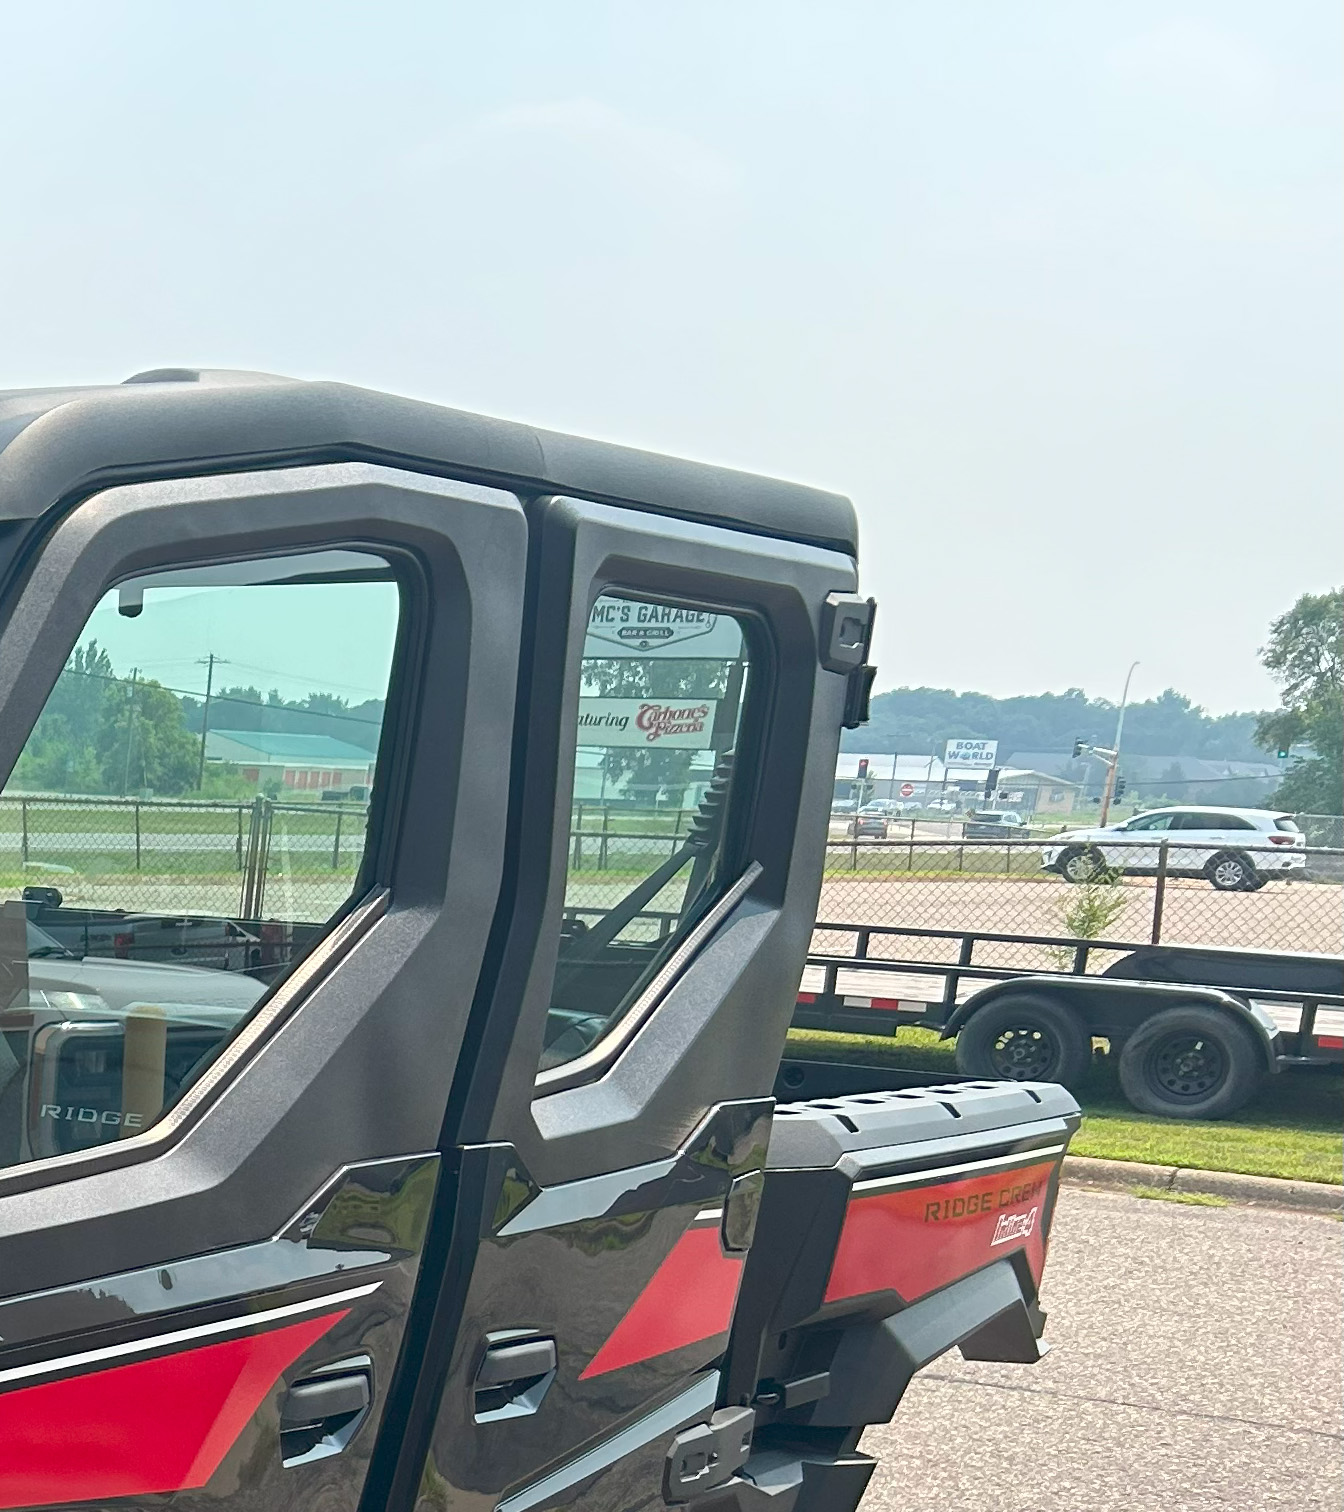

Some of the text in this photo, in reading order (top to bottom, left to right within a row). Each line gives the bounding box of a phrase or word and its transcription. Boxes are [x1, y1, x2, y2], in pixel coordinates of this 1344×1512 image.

[592, 605, 705, 624] MC'S GARAGE
[578, 712, 630, 732] aturing
[956, 741, 989, 751] BOAT
[40, 1103, 145, 1128] RIDGE
[924, 1190, 994, 1223] RIDGE
